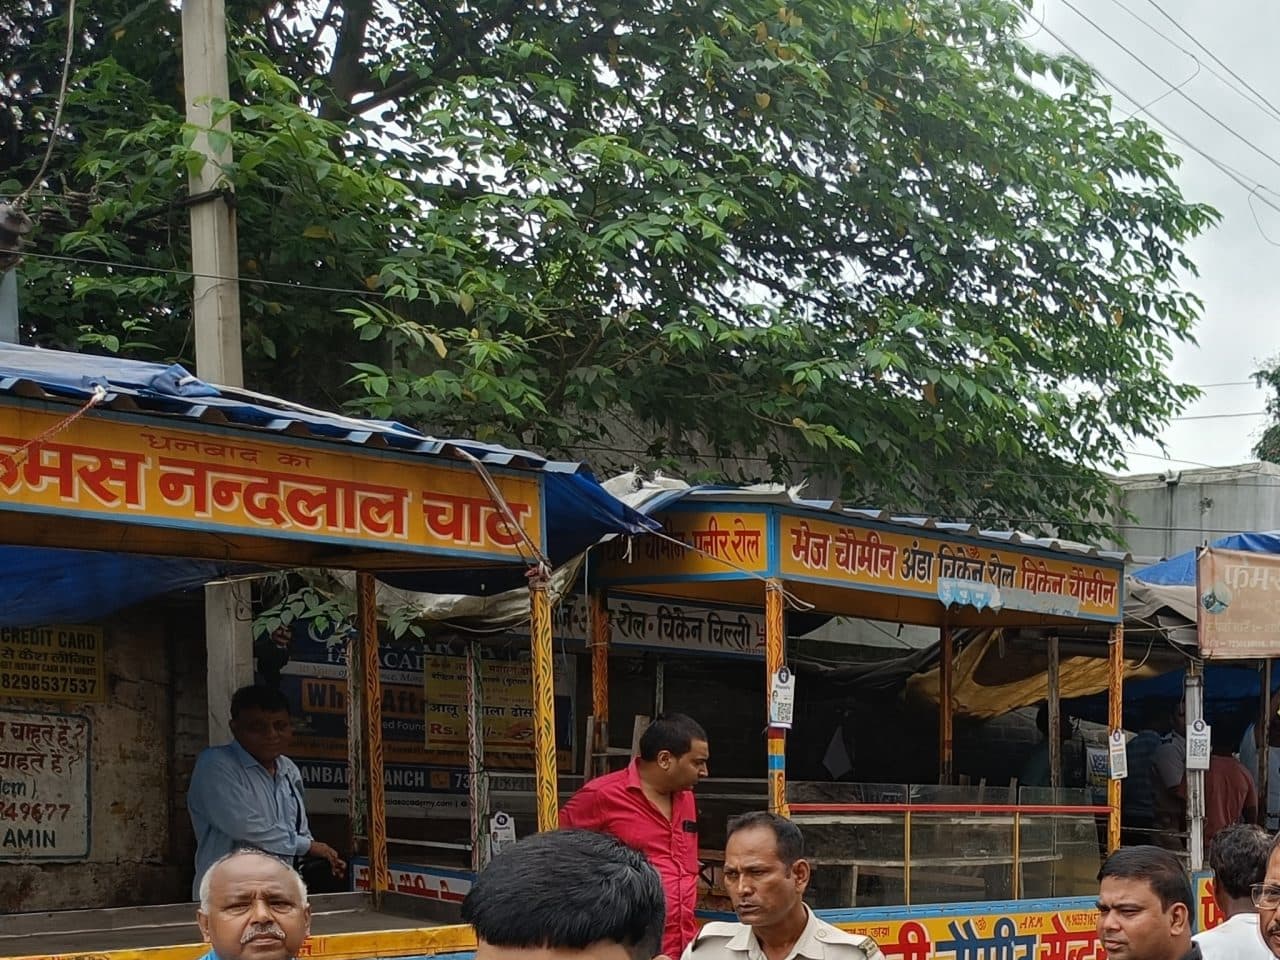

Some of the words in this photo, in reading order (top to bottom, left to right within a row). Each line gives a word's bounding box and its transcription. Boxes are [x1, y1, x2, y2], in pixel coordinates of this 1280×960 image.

[140, 432, 259, 464] धनबाद
[159, 457, 409, 537] नन्दलाल
[901, 541, 934, 583] अंडा
[58, 631, 96, 650] CARD
[2, 676, 97, 694] 8298537537
[4, 828, 56, 849] AMIN
